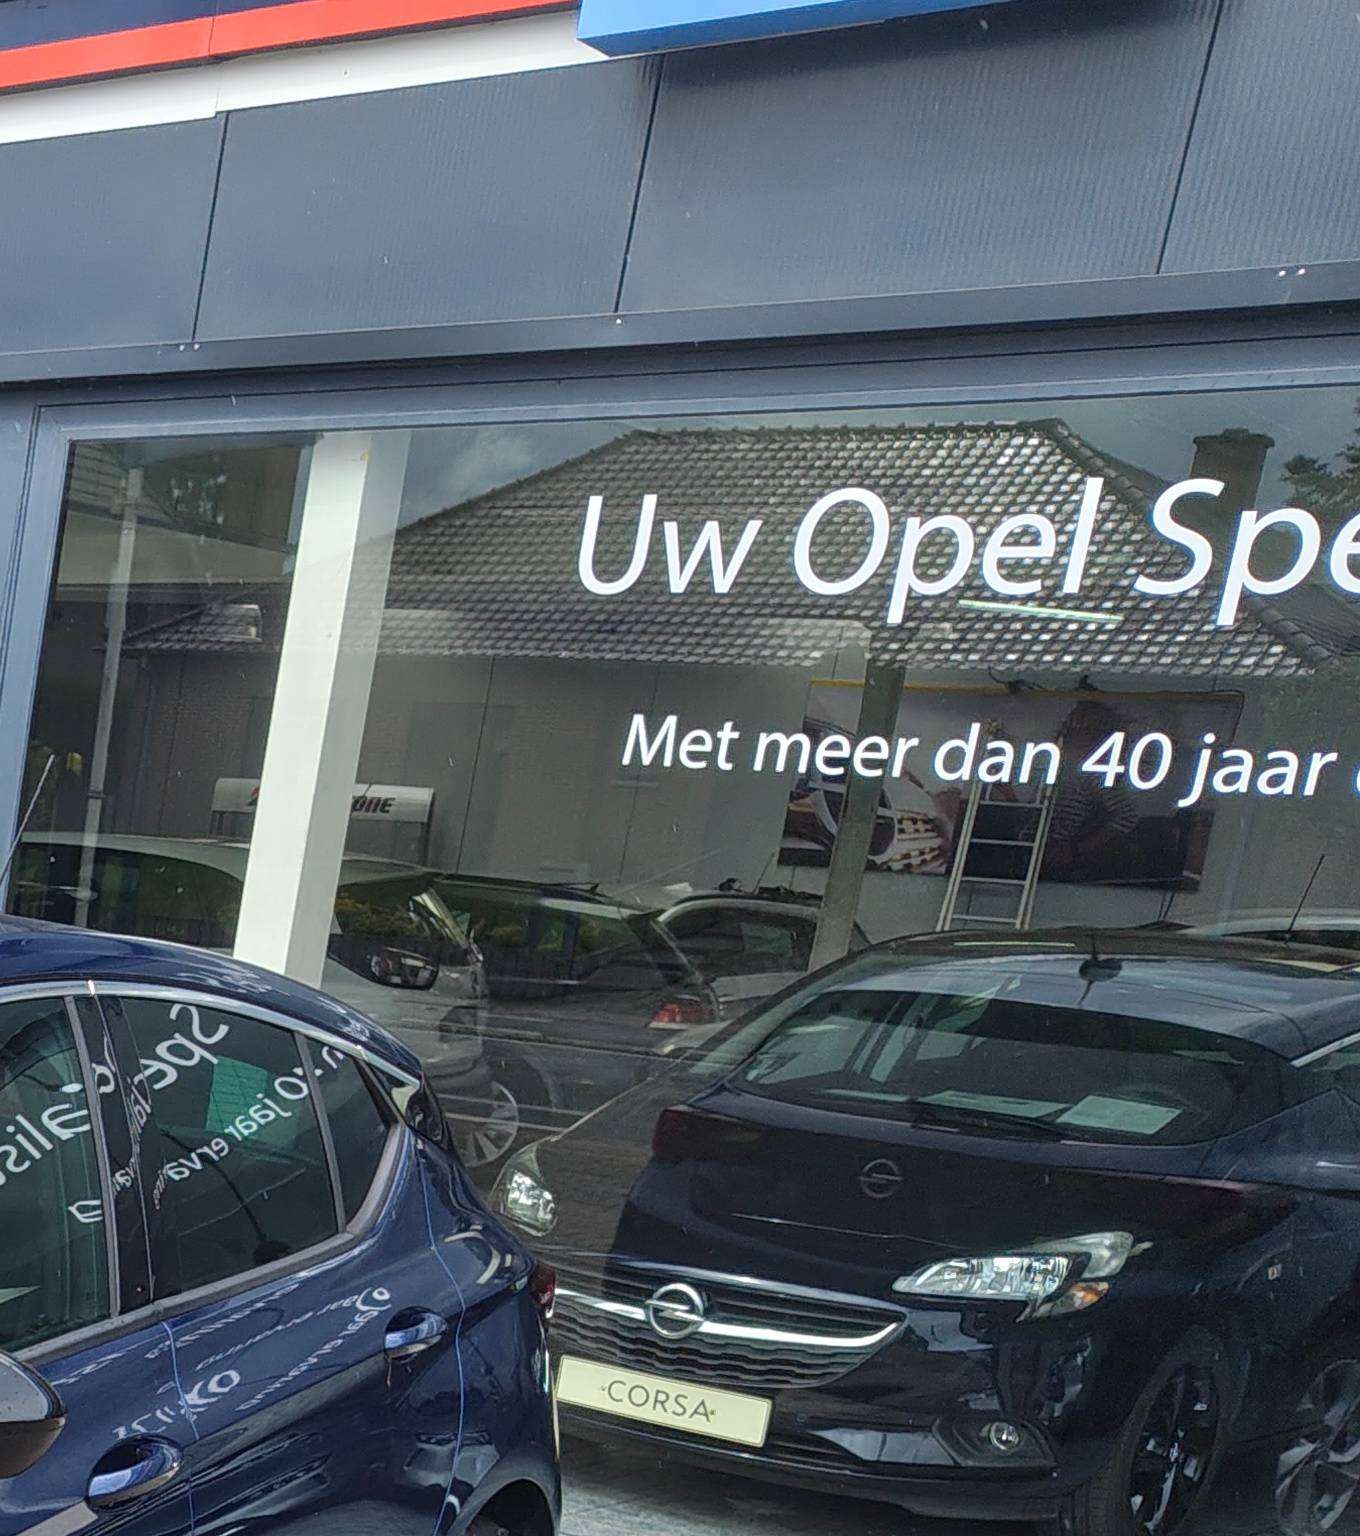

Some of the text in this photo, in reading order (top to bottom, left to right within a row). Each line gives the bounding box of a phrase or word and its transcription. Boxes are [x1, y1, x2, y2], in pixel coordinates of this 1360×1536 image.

[578, 495, 762, 596] Uw
[792, 477, 1102, 624] Opel
[622, 713, 740, 771] Met
[752, 730, 919, 779] meer
[933, 723, 1061, 784] dan
[1081, 731, 1172, 790] 40
[1177, 732, 1338, 807] jaar
[607, 1379, 711, 1423] CORSA
